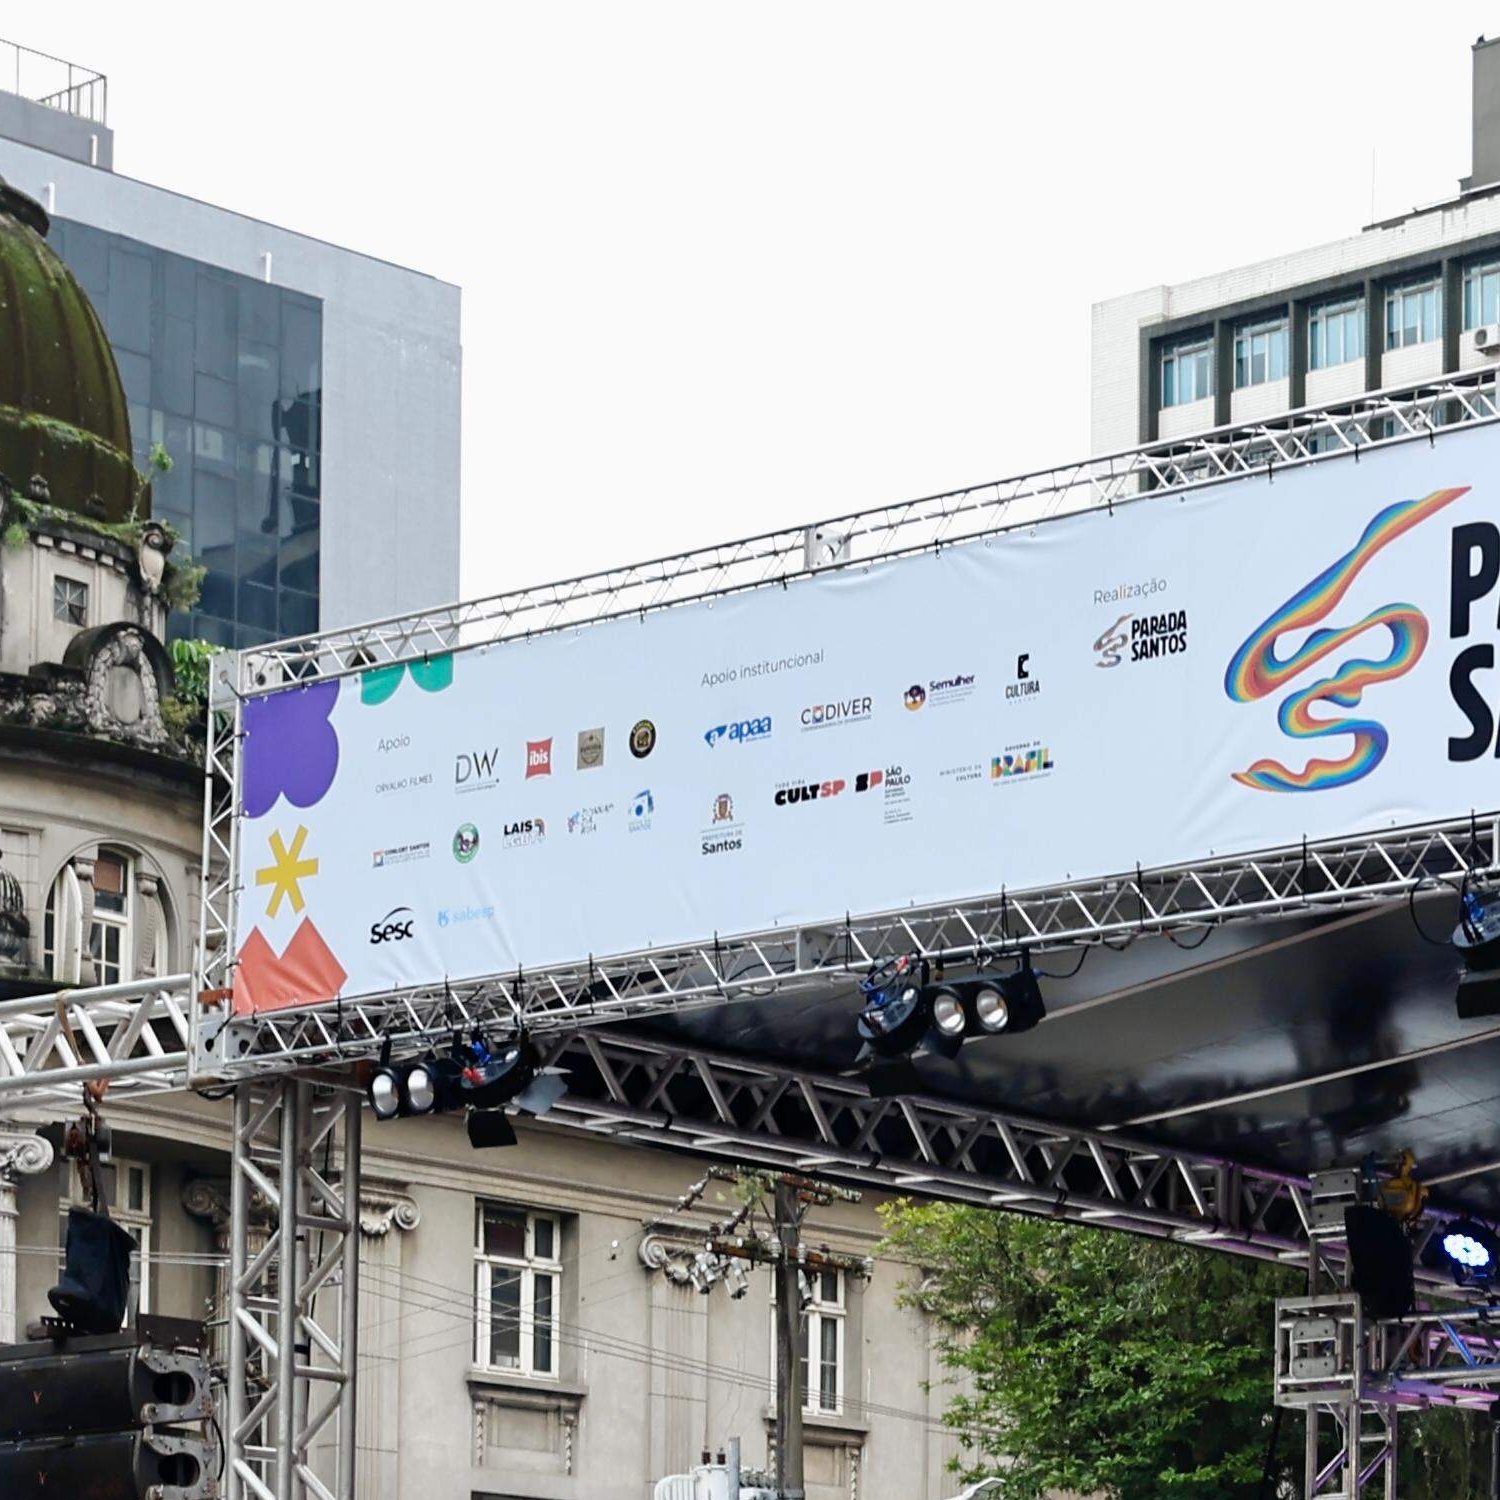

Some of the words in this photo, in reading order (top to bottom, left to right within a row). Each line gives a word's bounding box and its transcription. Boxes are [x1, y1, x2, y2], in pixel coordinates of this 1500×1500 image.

[1093, 578, 1167, 605] Realização
[1131, 609, 1187, 640] PARADA
[1131, 631, 1187, 662] SANTOS
[701, 668, 737, 687] Apoio
[929, 674, 975, 691] Semulher
[1005, 680, 1041, 699] CULTURA
[729, 716, 772, 743] apaa
[378, 734, 411, 753] Apoio
[529, 748, 549, 767] ibis
[885, 765, 902, 777] SÃO
[885, 775, 911, 788] PAULO
[504, 820, 533, 836] LAIS
[701, 837, 743, 855] Santos
